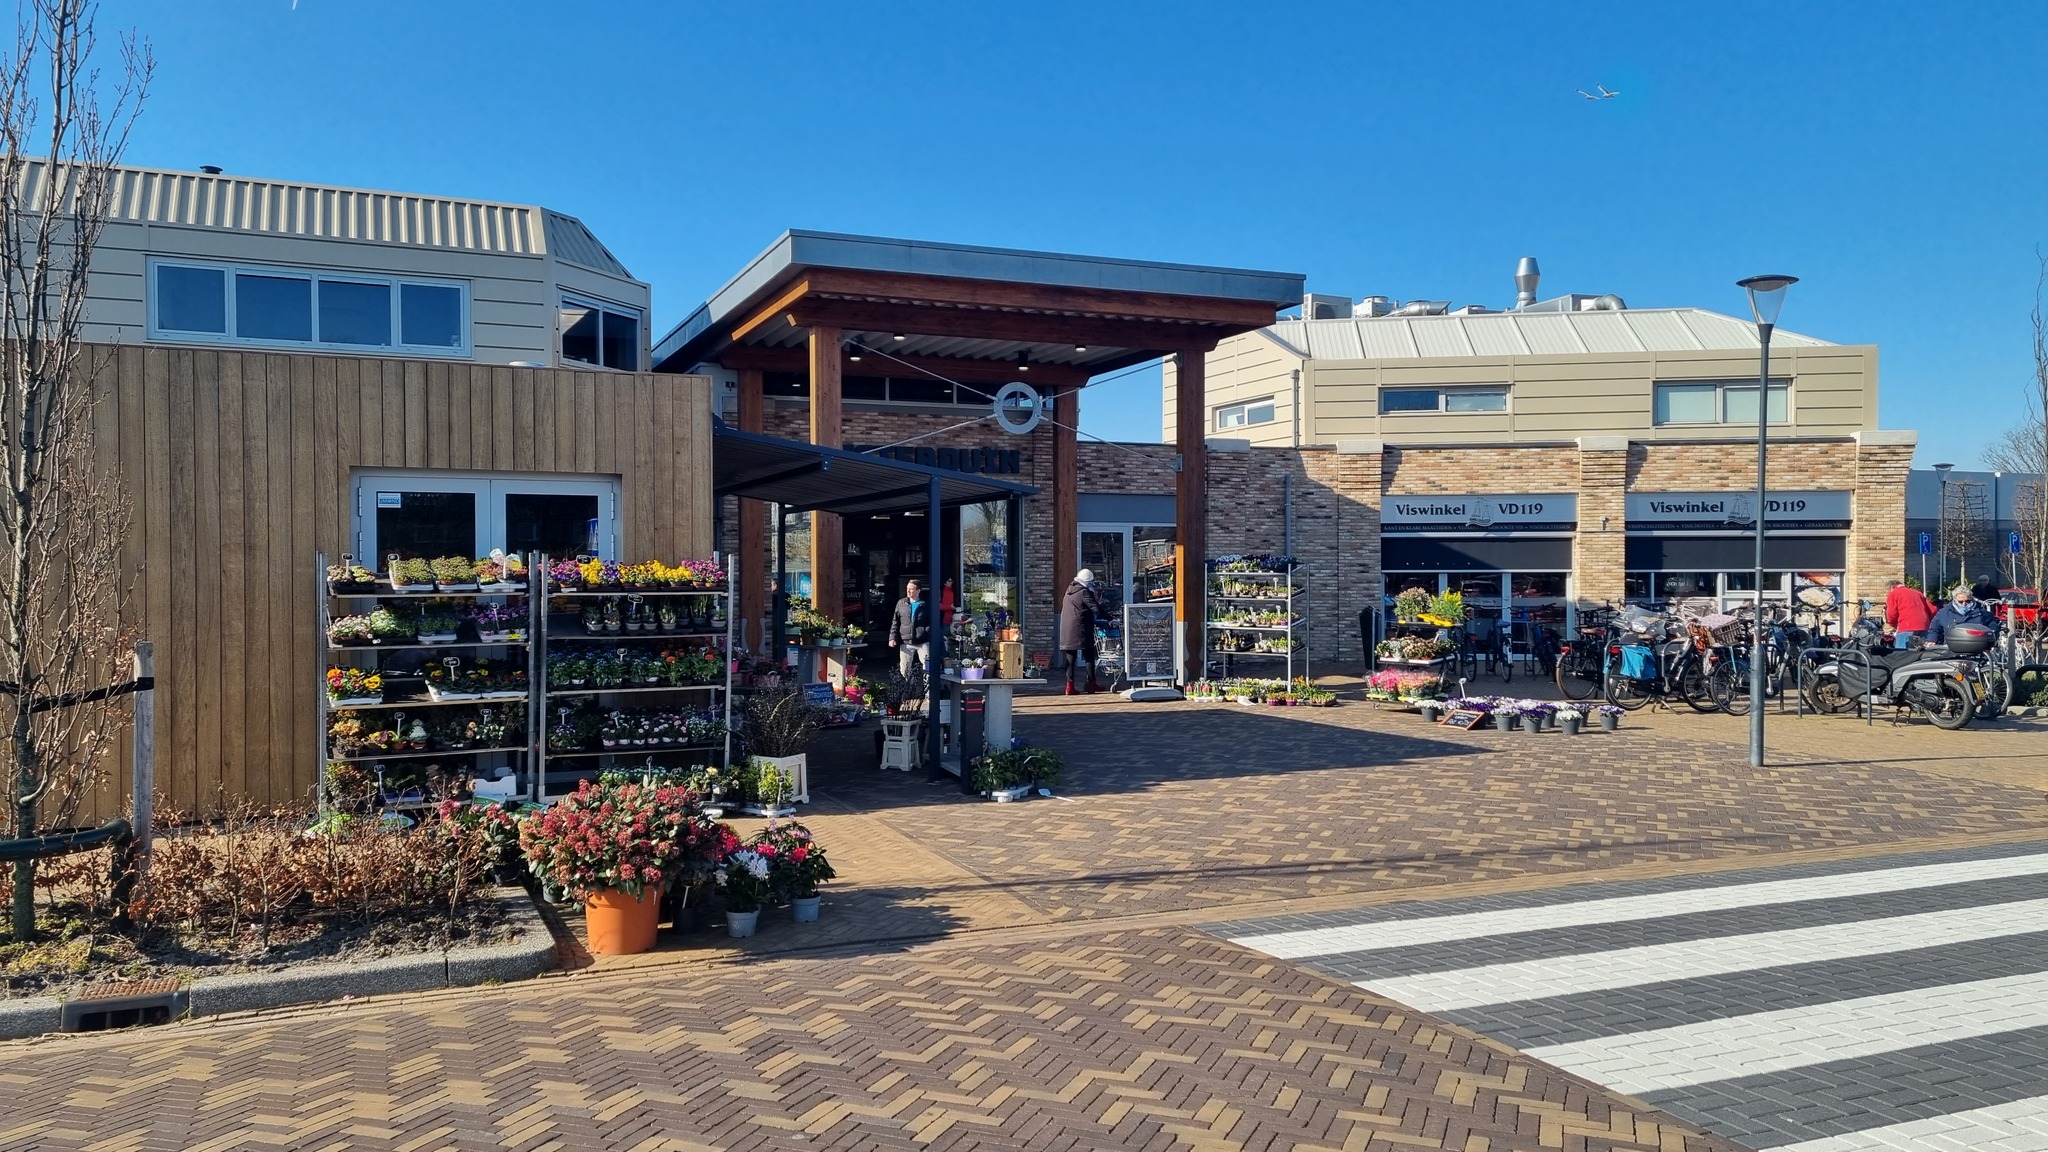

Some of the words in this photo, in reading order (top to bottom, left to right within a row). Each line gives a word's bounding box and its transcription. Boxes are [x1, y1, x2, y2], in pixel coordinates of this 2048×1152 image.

[1395, 504, 1466, 515] Viswinkel
[1498, 503, 1543, 514] VD119
[1650, 501, 1724, 513] Viswinkel
[1922, 535, 1929, 546] P
[2012, 535, 2018, 546] P
